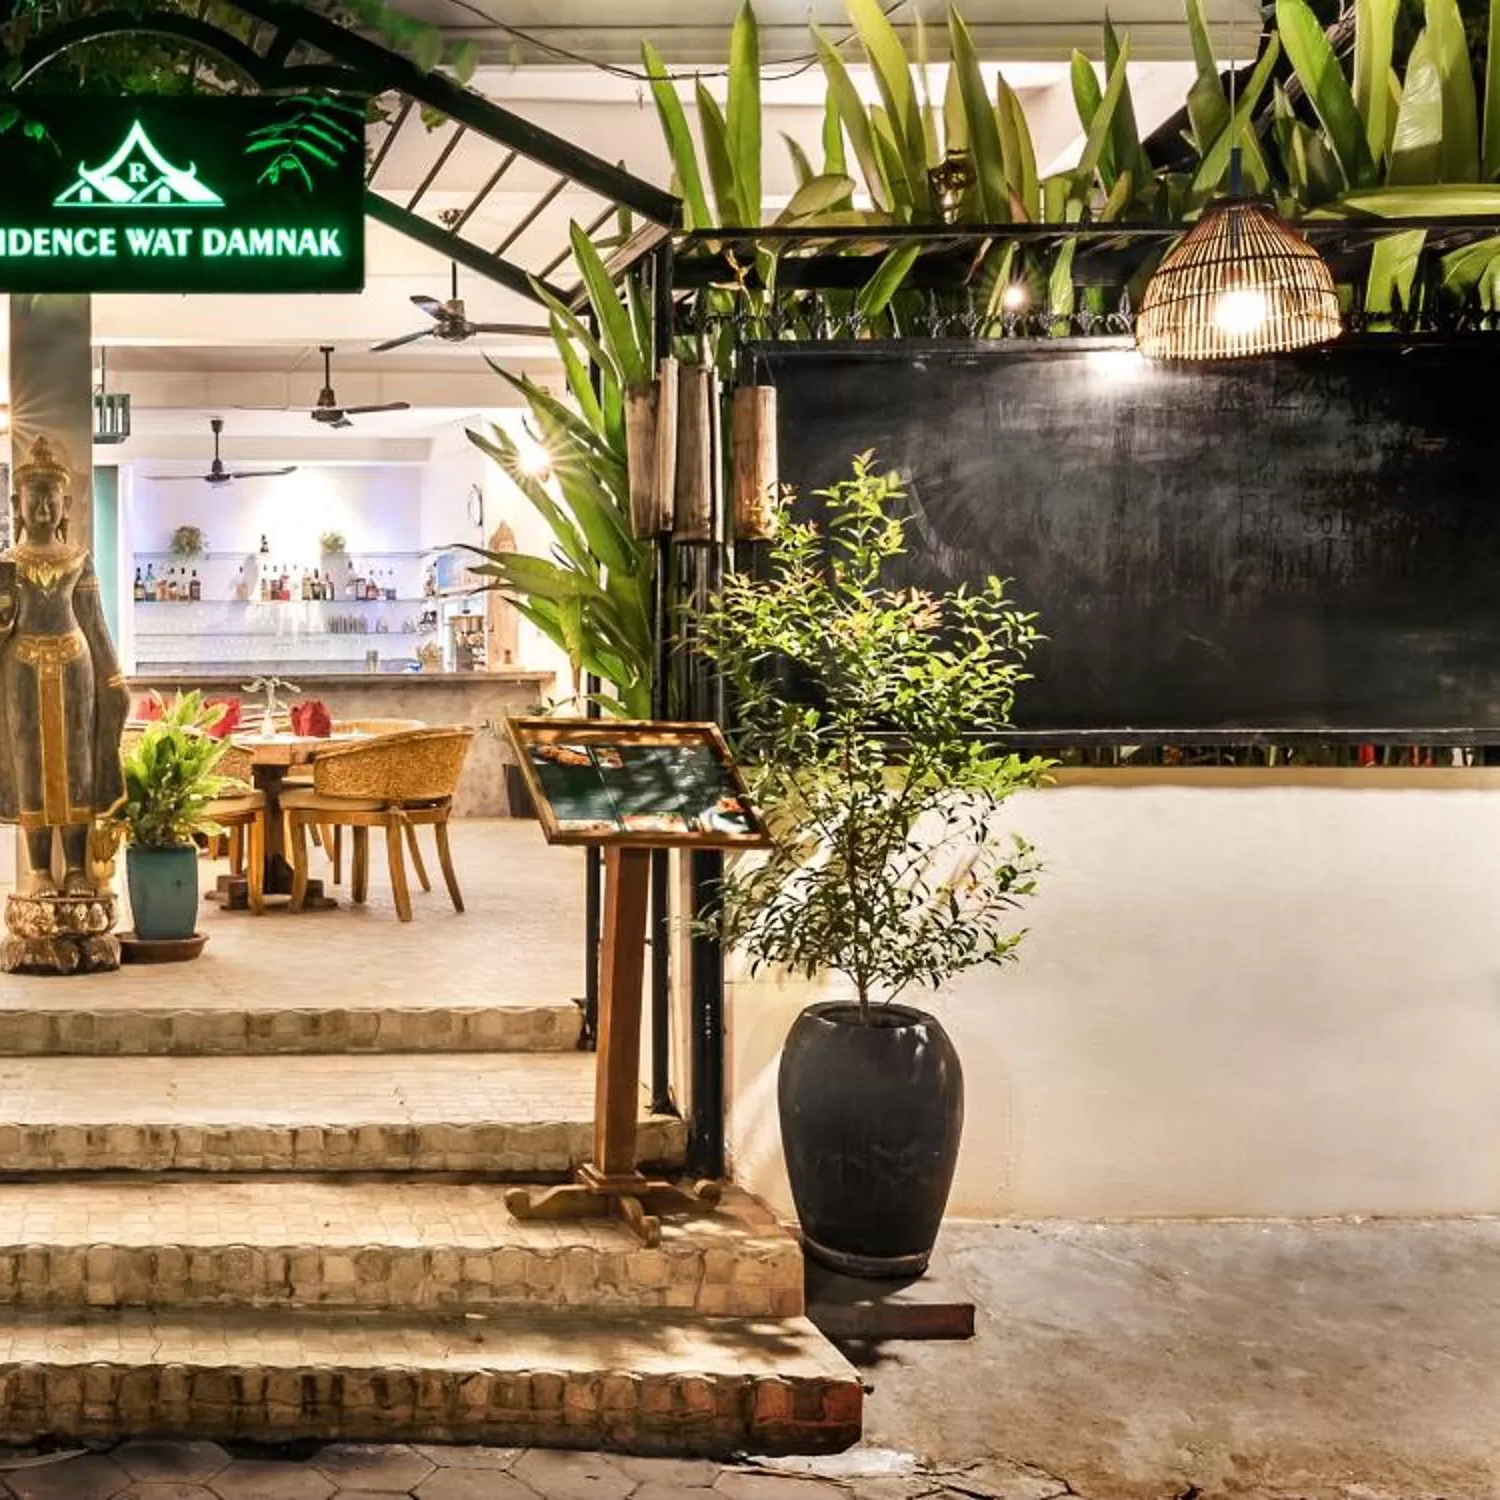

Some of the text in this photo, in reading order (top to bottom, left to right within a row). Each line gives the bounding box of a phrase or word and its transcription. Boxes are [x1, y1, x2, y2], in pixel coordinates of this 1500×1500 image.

[129, 163, 148, 183] R
[125, 228, 192, 256] WAT
[203, 229, 341, 256] DAMNAK
